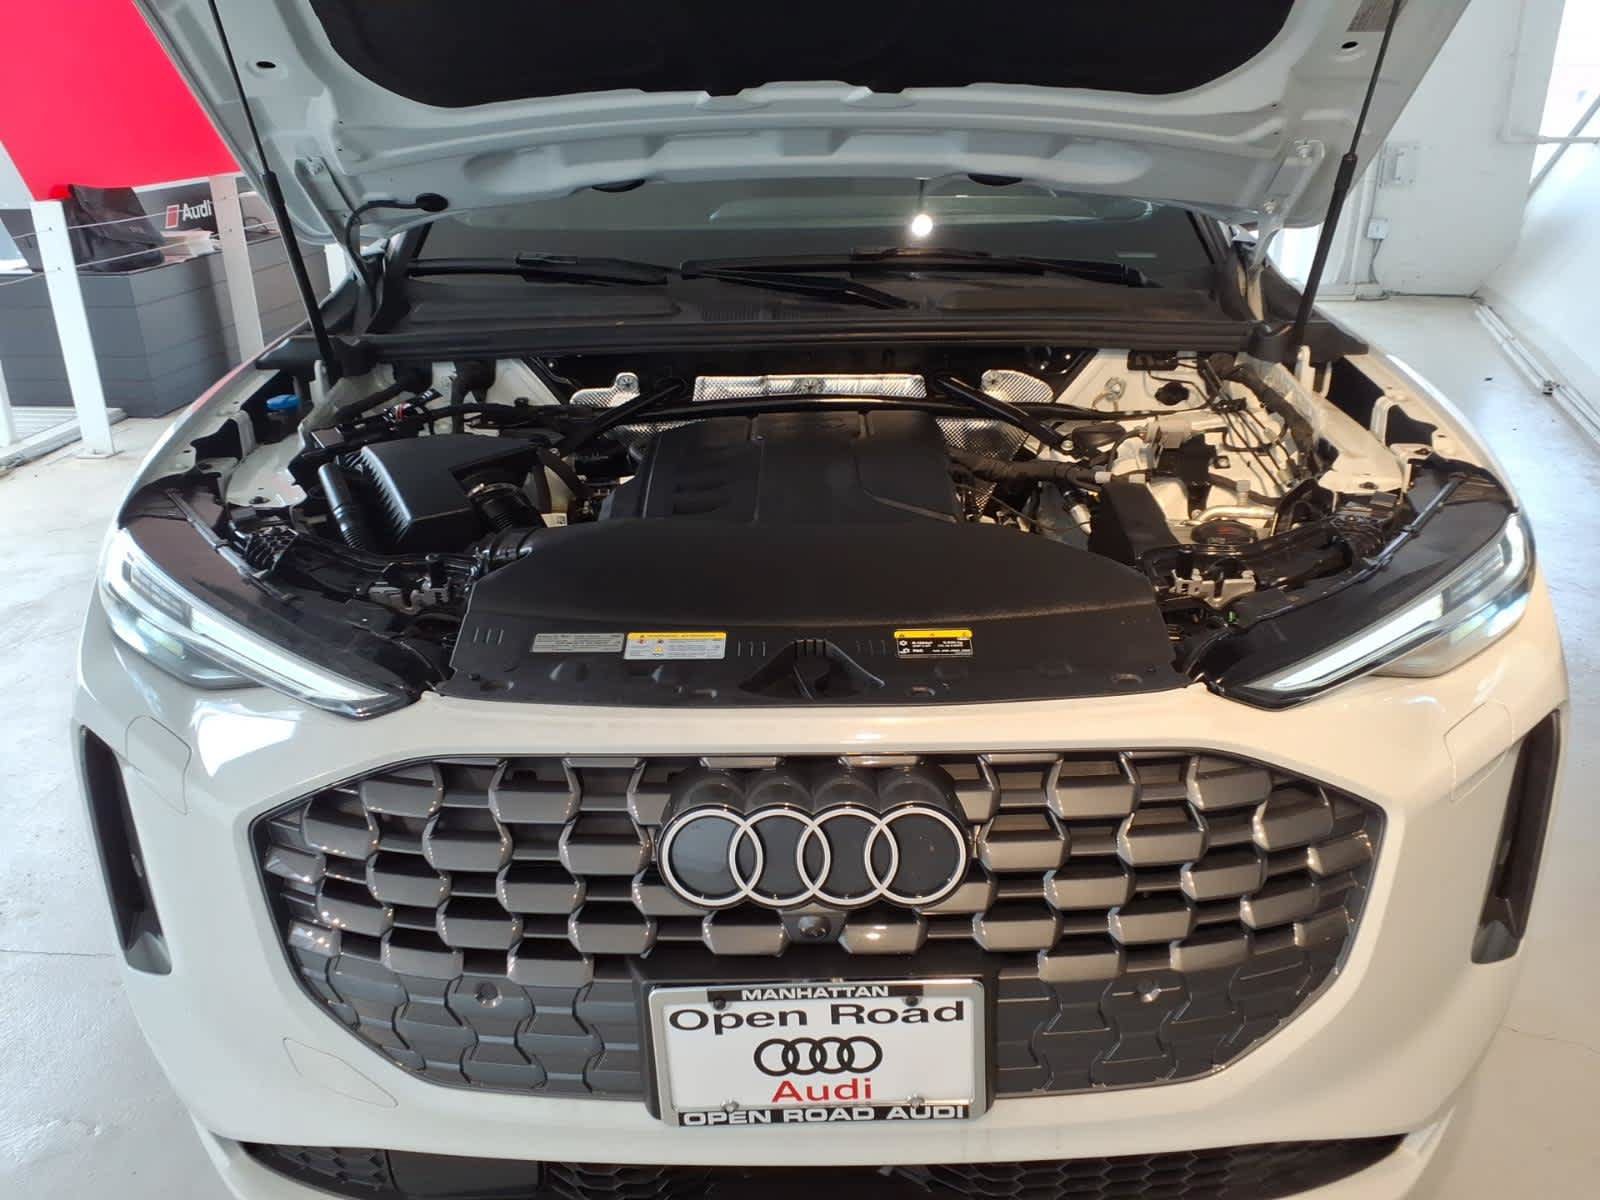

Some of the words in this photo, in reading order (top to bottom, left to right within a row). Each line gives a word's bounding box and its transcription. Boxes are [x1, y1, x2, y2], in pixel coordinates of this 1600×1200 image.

[183, 200, 212, 221] Audi
[741, 986, 889, 1001] MANHATTAN
[669, 1008, 808, 1035] Open
[830, 1001, 964, 1024] Road
[771, 1078, 872, 1102] Audi
[683, 1110, 772, 1126] OPEN
[783, 1107, 875, 1122] ROAD
[886, 1104, 964, 1119] AUDI
